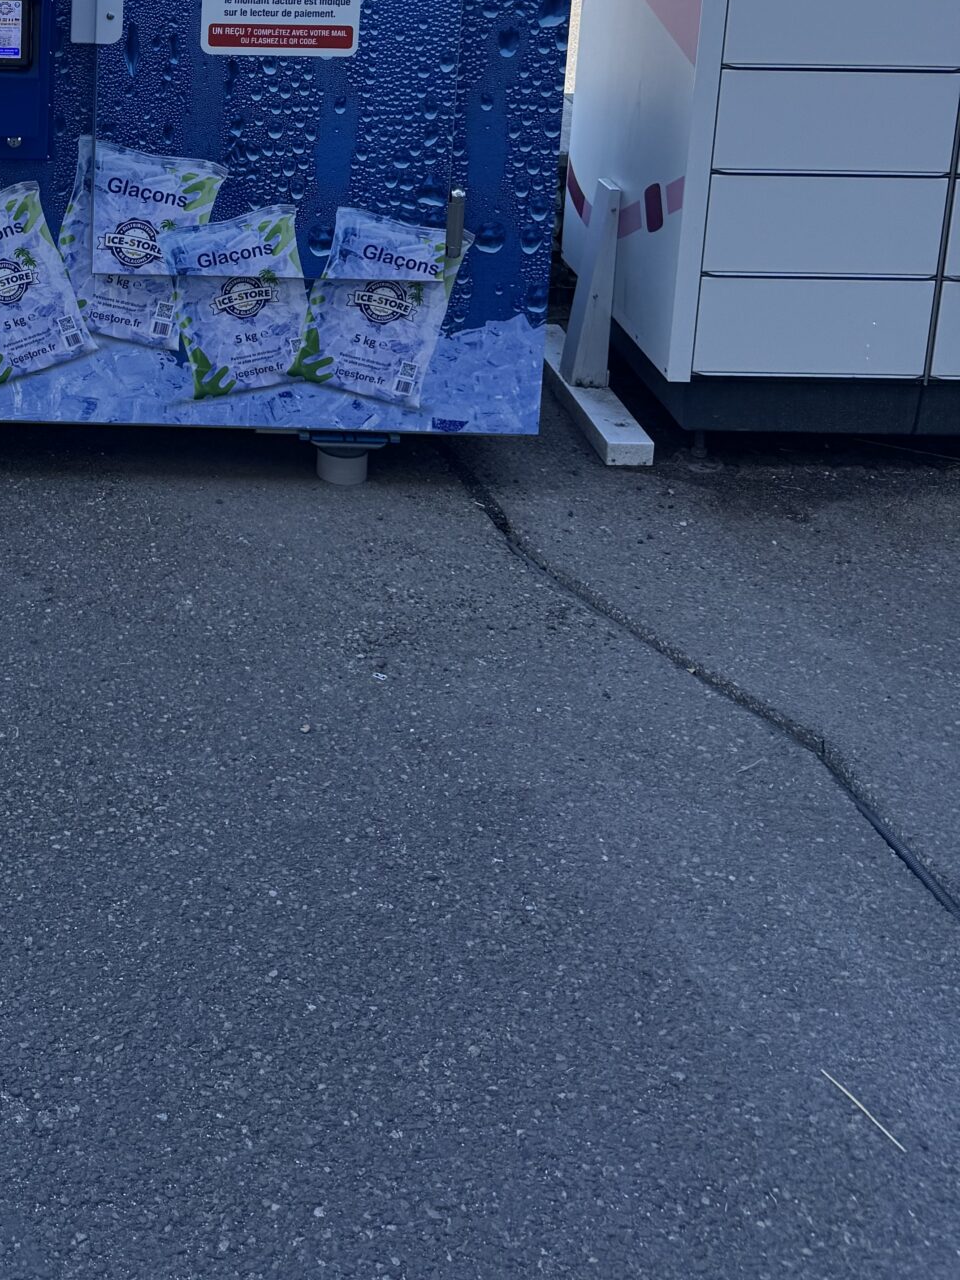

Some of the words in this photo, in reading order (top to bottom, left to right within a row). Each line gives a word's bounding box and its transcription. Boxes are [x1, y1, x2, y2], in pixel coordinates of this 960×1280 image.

[224, 9, 238, 17] sur
[240, 8, 248, 17] le
[250, 8, 280, 17] lecteur
[281, 9, 292, 18] de
[294, 9, 336, 19] paiement.
[212, 27, 223, 35] UN
[225, 27, 245, 36] REÇU
[107, 176, 188, 208] Glaçons
[197, 243, 274, 269] Glaçons
[363, 244, 439, 276] Glaçons
[218, 289, 271, 307] ICE-STORE
[356, 293, 410, 314] ICE-STORE
